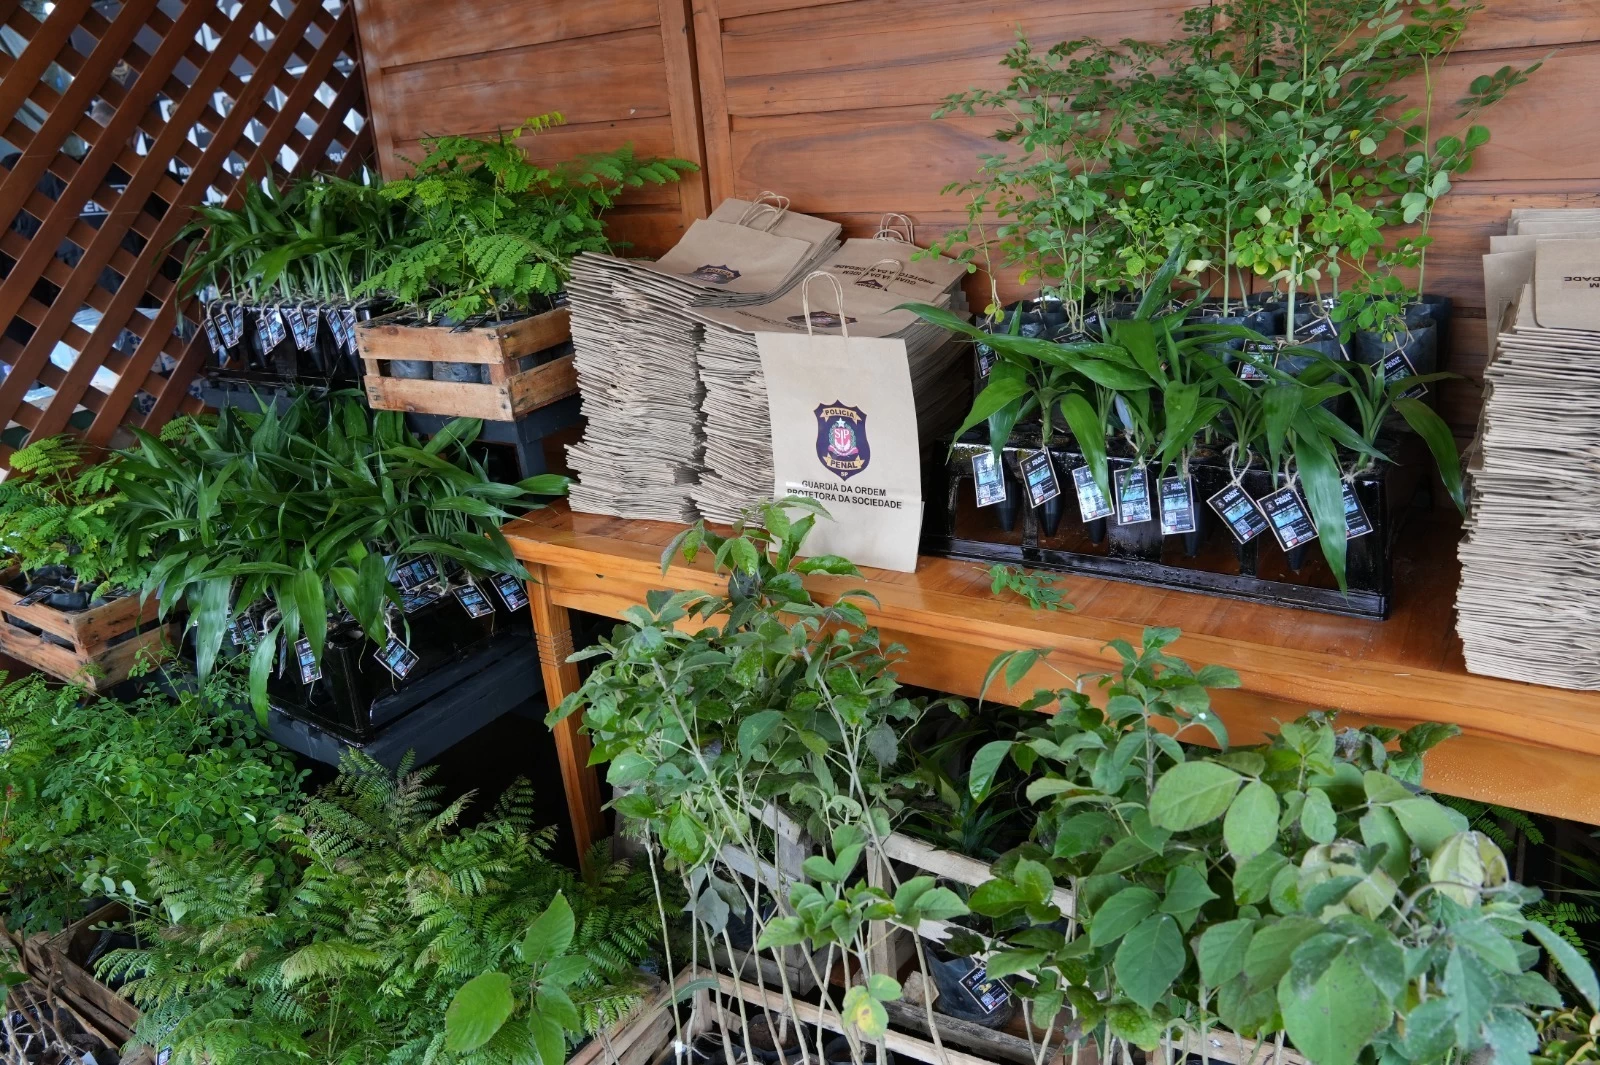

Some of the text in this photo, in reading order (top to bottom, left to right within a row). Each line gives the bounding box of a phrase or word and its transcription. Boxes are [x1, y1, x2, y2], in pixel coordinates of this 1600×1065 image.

[830, 460, 858, 469] PENAL
[802, 480, 886, 496] GUARDIÃ DA ORDEM
[838, 495, 851, 503] DA
[852, 496, 902, 509] SOCIEDADE
